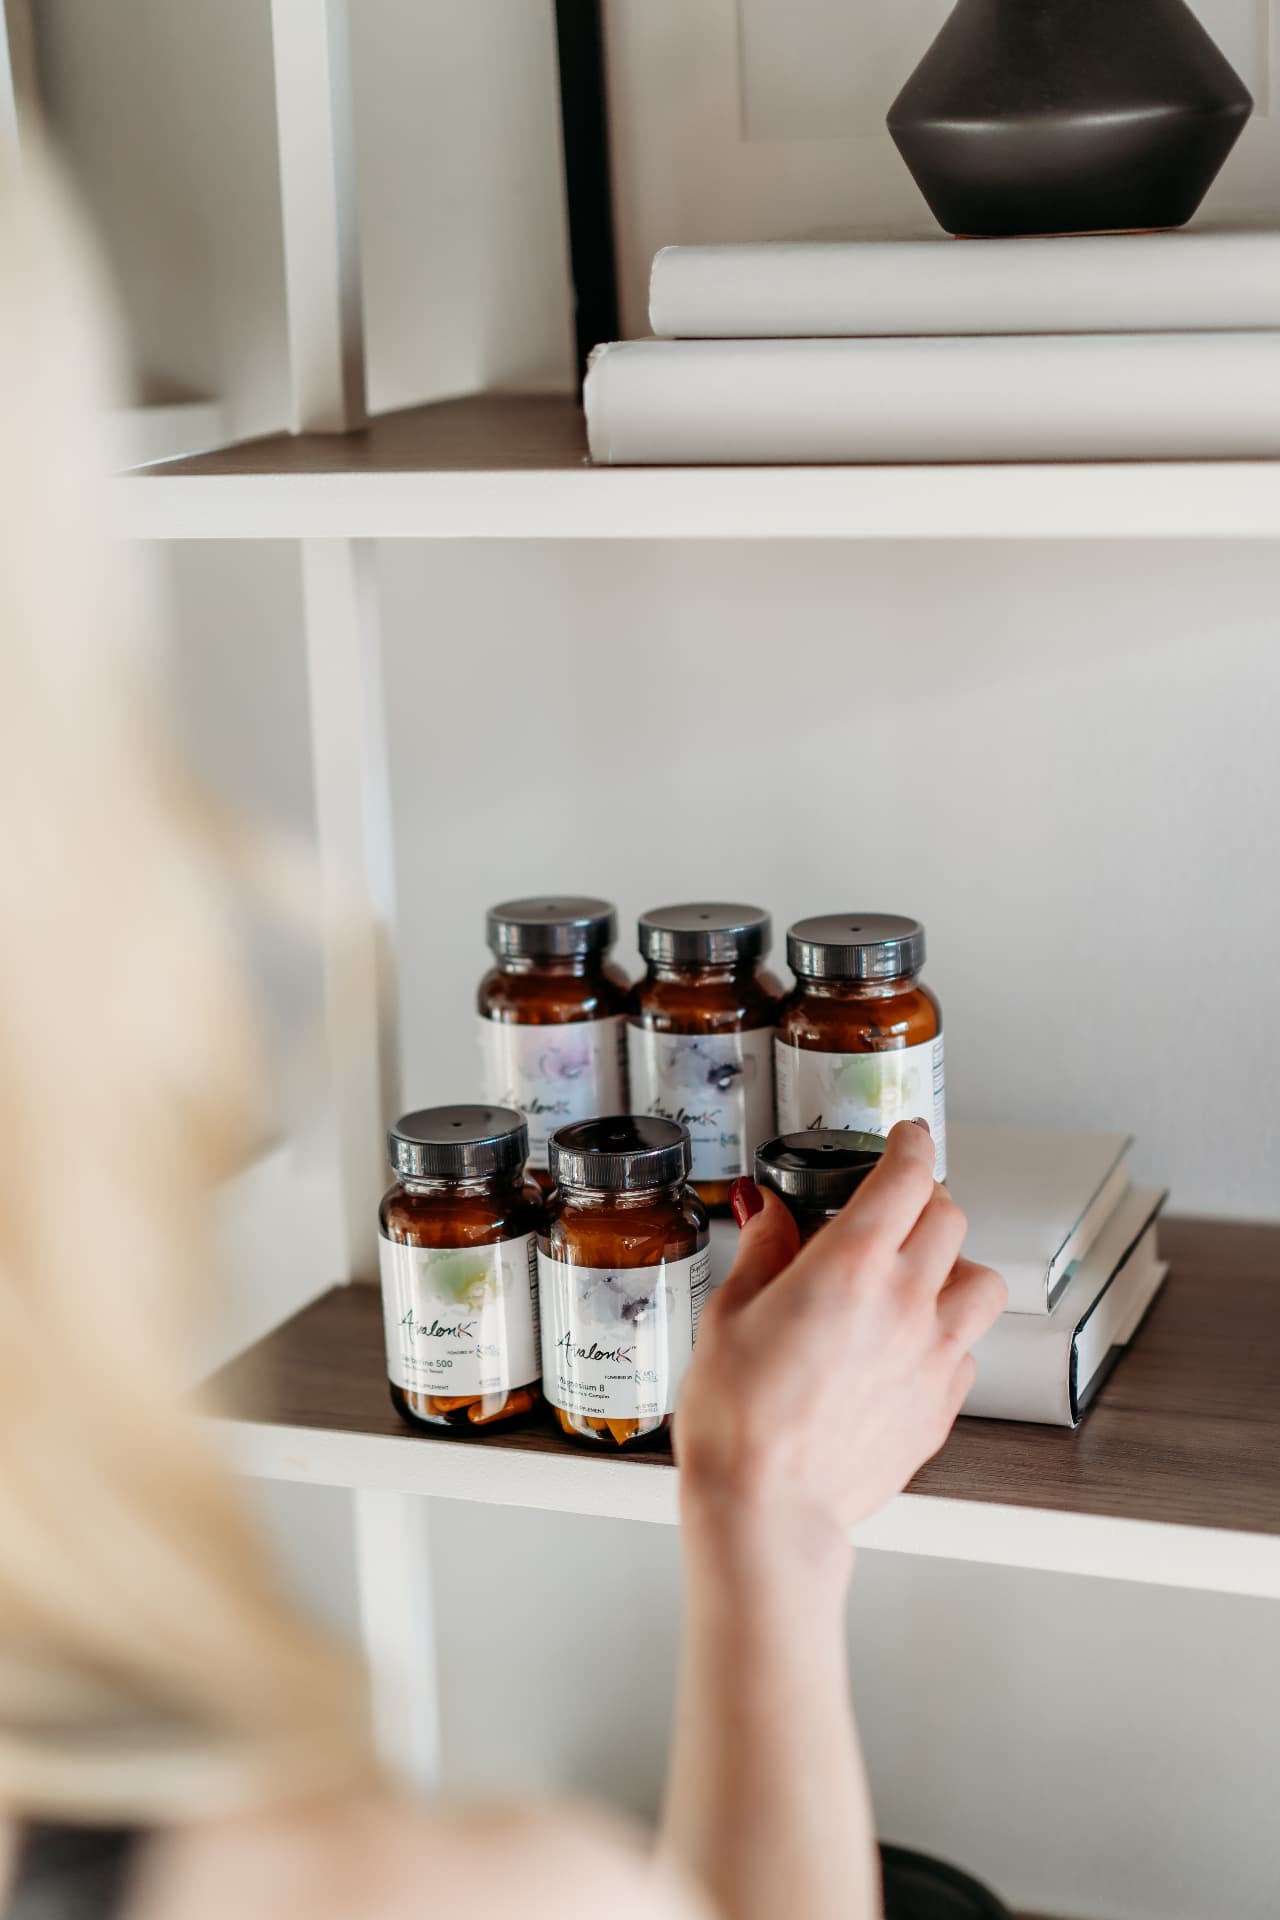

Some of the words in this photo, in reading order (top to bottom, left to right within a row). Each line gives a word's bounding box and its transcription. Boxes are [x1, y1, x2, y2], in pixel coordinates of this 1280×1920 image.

[555, 1330, 633, 1368] AvalonK
[435, 1359, 453, 1368] 500
[599, 1384, 605, 1392] B
